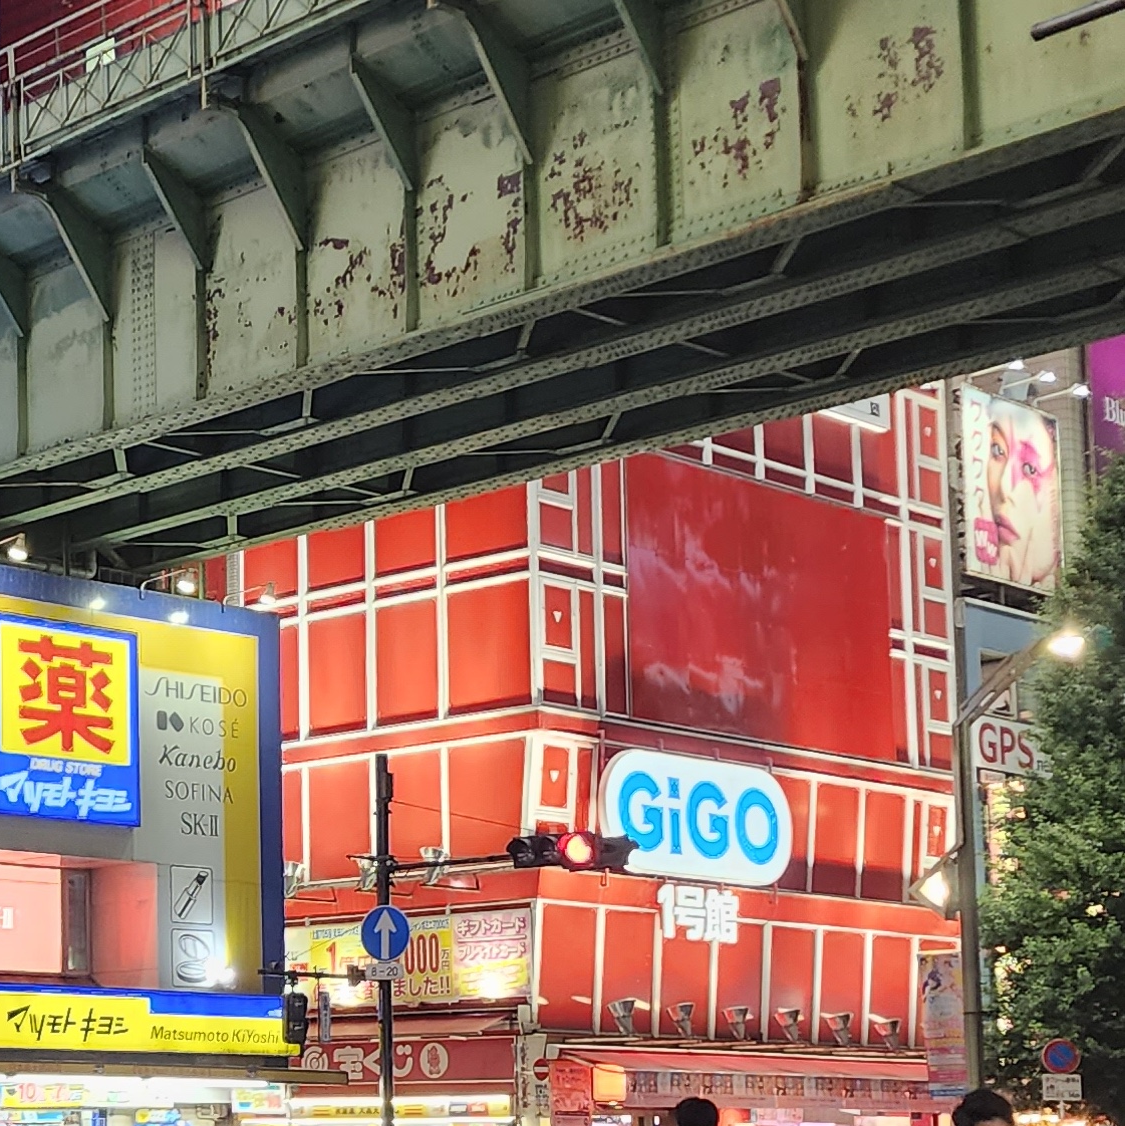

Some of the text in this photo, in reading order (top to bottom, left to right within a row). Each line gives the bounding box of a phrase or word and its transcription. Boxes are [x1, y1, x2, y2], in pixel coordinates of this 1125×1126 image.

[17, 634, 115, 754] 薬
[144, 677, 247, 707] SHISEIDO
[189, 717, 239, 738] KOSÉ
[159, 744, 237, 772] Kanebo
[979, 722, 1034, 769] GPS
[30, 758, 102, 777] DRUG STORE
[165, 780, 234, 805] SOFINA
[619, 770, 779, 866] GiGO
[457, 917, 526, 936] ギフトカード
[657, 884, 740, 944] 1号館
[6, 1004, 129, 1042] マツモトキヨシ
[150, 1026, 279, 1044] Matsumoto KiYoshi
[333, 1045, 414, 1080] 宝くじ
